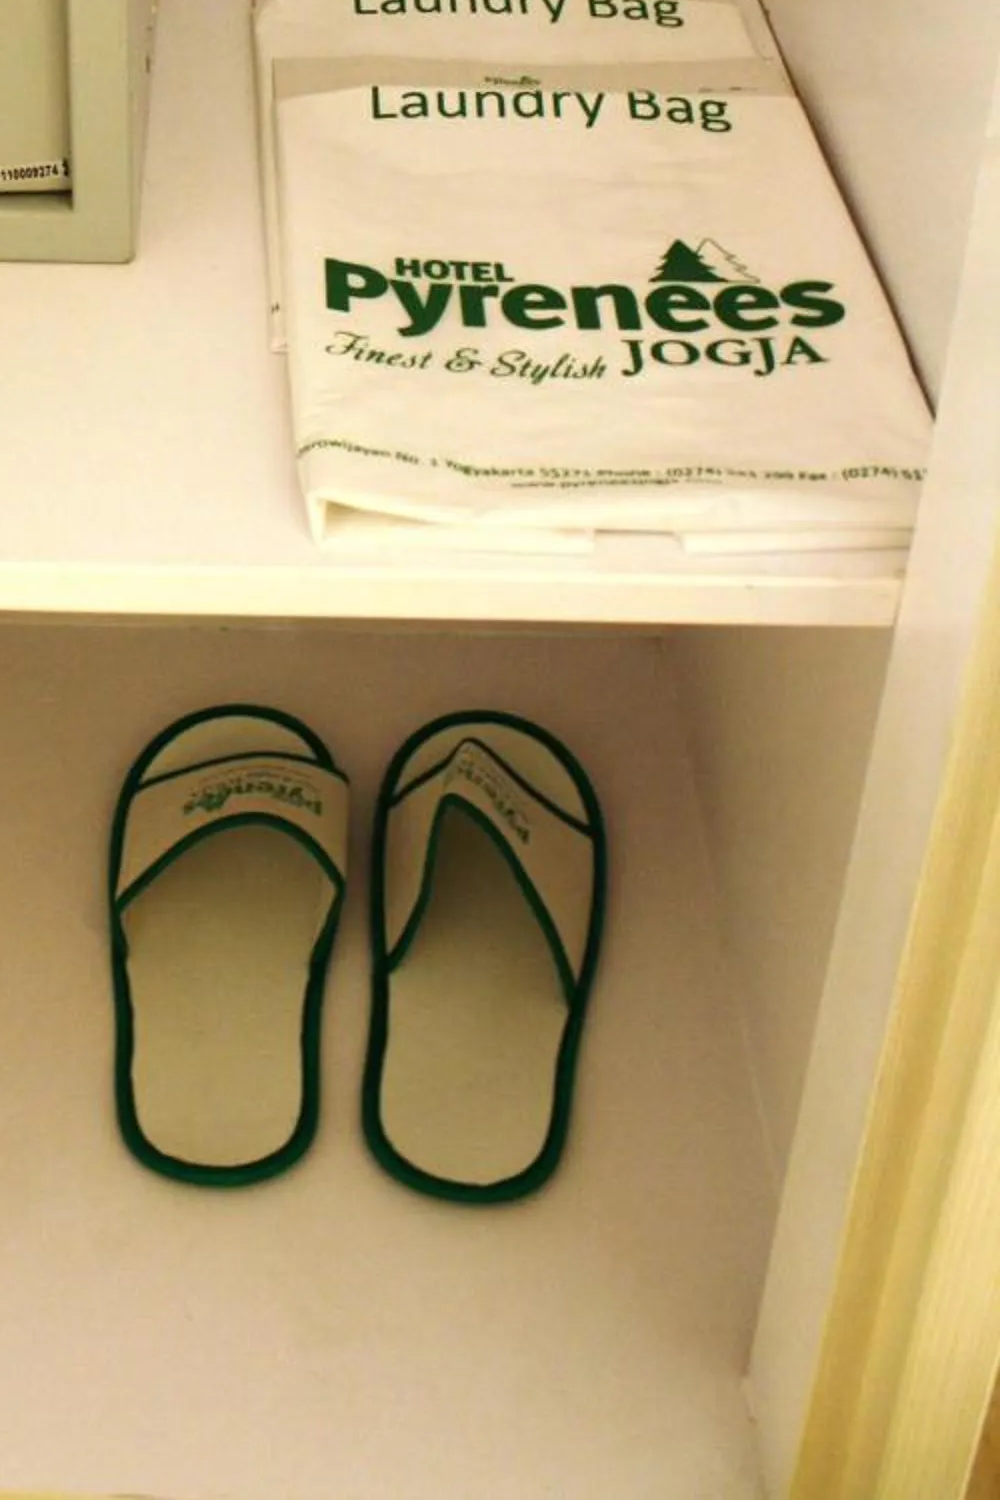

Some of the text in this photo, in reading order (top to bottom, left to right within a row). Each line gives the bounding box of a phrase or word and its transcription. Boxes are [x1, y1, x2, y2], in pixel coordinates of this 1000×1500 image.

[371, 86, 732, 133] Laundry Bag
[394, 256, 515, 283] HOTEL
[324, 256, 846, 338] Pyrenees
[324, 330, 830, 385] Finest & Stylish JOGJA
